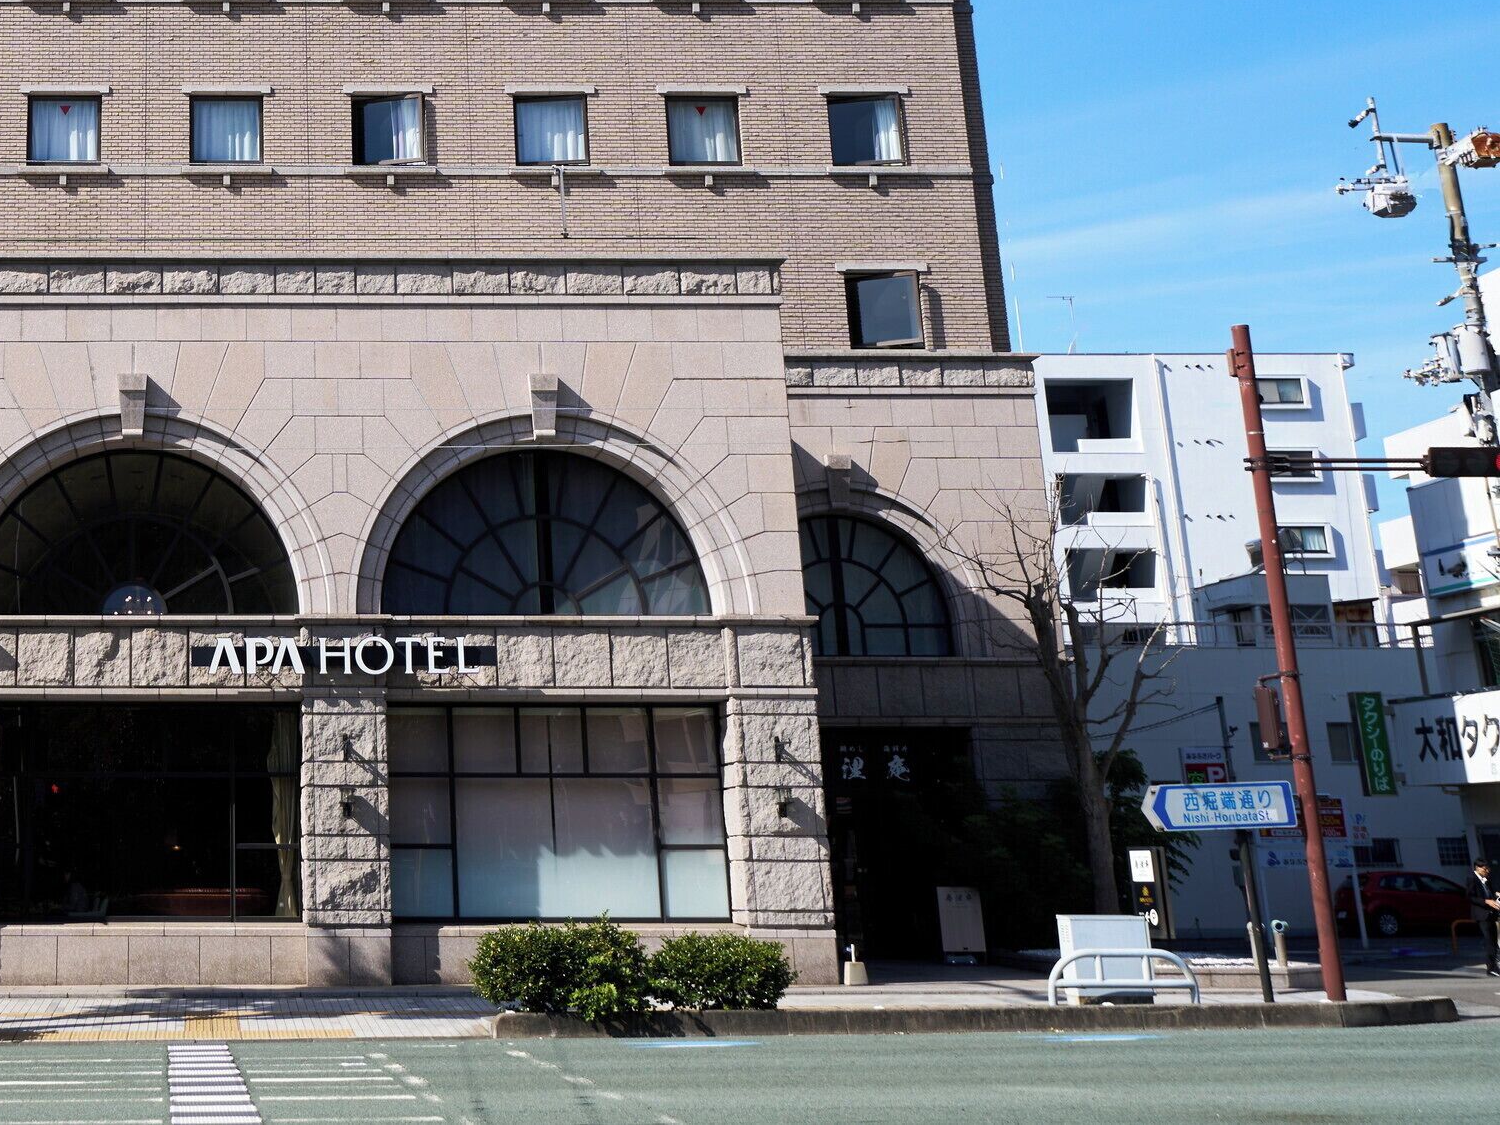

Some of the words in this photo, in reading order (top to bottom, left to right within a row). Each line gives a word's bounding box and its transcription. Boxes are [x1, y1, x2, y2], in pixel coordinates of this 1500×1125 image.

[209, 637, 306, 675] APA
[319, 635, 481, 676] HOTEL
[1361, 696, 1390, 792] タクシーのりば
[1206, 766, 1225, 783] P
[1183, 789, 1272, 812] 西堀端通り
